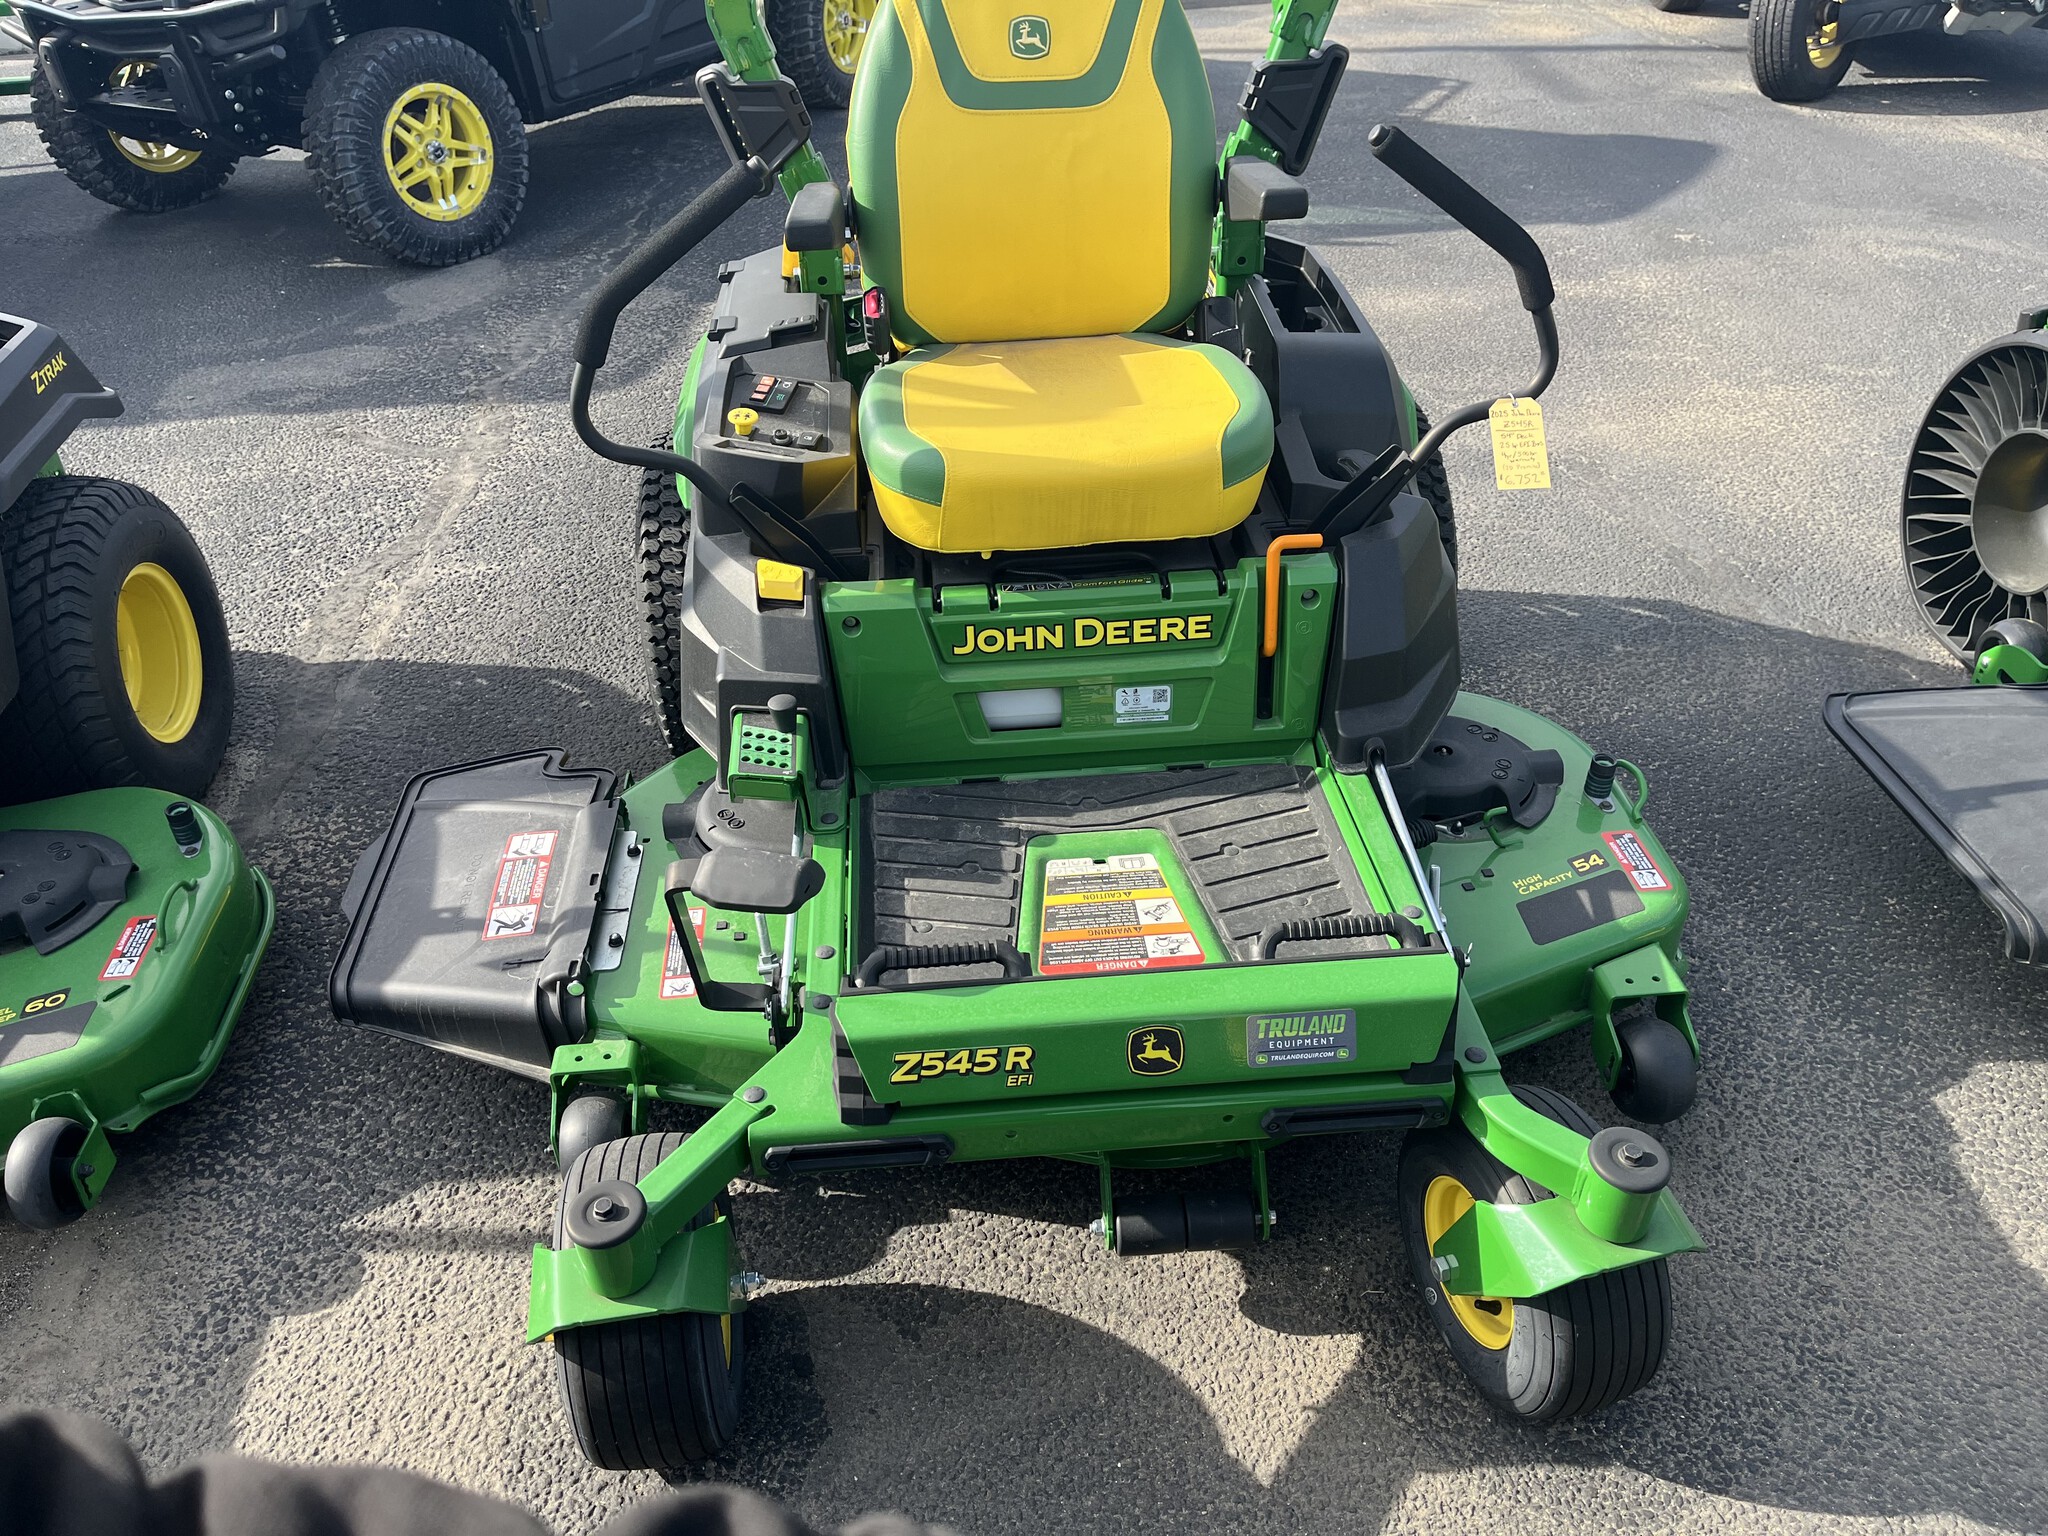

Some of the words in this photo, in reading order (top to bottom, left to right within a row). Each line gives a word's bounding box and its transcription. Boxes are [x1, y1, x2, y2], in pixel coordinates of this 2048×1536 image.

[30, 351, 67, 395] ZTRAK
[1491, 410, 1509, 418] 2025
[1511, 409, 1525, 417] John
[1503, 420, 1534, 429] Z545R
[953, 623, 1066, 655] JOHN
[1073, 614, 1213, 649] DEERE
[1572, 853, 1605, 873] 54
[532, 868, 547, 899] DANGER
[1512, 873, 1543, 889] HIGH
[1518, 870, 1574, 896] CAPACITY
[1083, 891, 1122, 900] CAUTION
[1088, 927, 1133, 937] WARNING
[1096, 960, 1137, 970] DANGER
[24, 993, 67, 1013] 60
[1256, 1013, 1347, 1039] TRULAND
[1269, 1037, 1335, 1049] EQUIPMENT
[1271, 1051, 1335, 1061] TRULANDEQUIP.COM
[890, 1047, 1001, 1085] Z545
[1005, 1045, 1035, 1073] R
[1006, 1073, 1034, 1087] EFI
